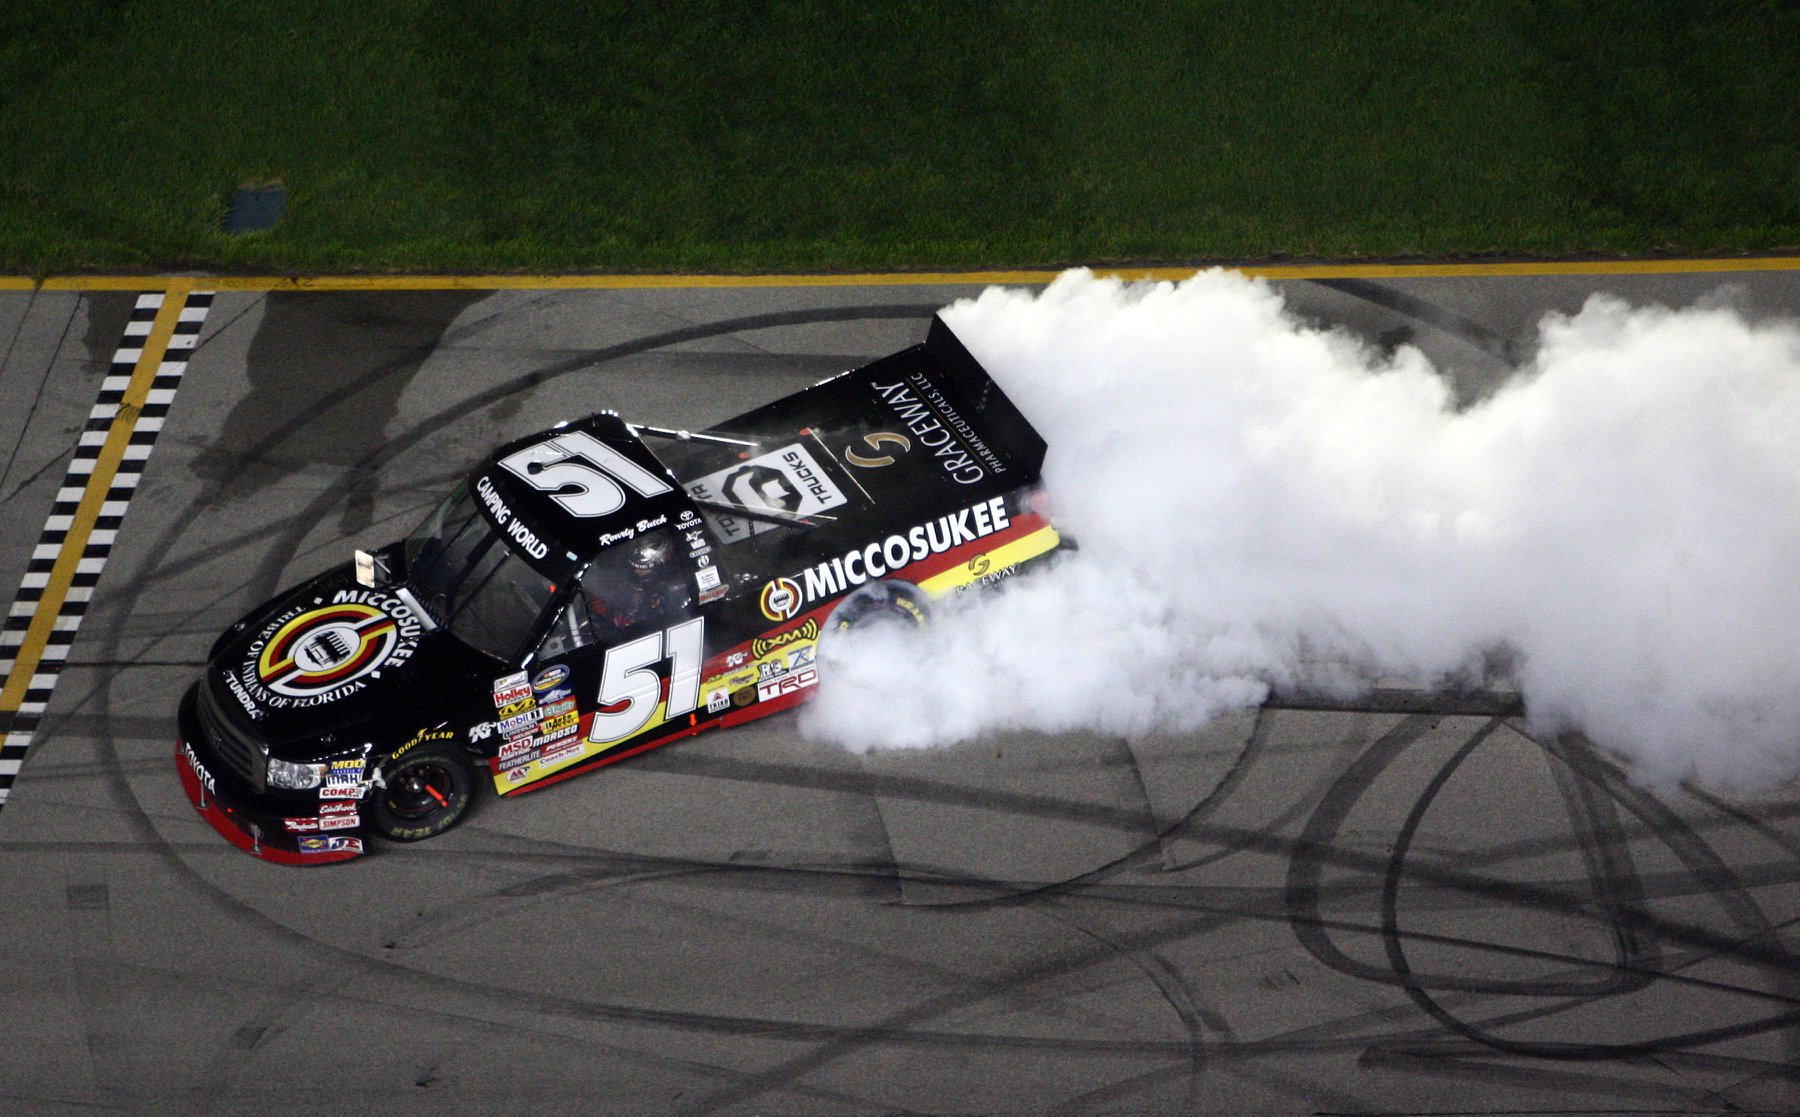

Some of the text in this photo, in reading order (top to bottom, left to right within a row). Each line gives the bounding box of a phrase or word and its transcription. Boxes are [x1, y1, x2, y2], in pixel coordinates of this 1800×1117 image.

[874, 382, 984, 484] GRACEWAY
[911, 372, 1006, 474] PHARMACEUTICALS, LLC
[498, 430, 674, 518] 51
[783, 451, 832, 504] TRUCKS
[477, 476, 548, 560] CAMPING WORLD
[599, 526, 635, 546] Rowdy
[677, 518, 702, 530] TOYOTA
[691, 484, 740, 537] TOTA
[803, 496, 1011, 603] MICCOSUKEE
[333, 590, 421, 667] MICCOSUKEE
[243, 606, 367, 708] TRIBE OF INDIANS OF FLORIDA
[589, 616, 704, 743] 51
[759, 669, 816, 694] TRD
[224, 670, 262, 720] TUNDRA
[495, 687, 530, 702] Holley
[392, 731, 454, 760] GOODYEAR
[500, 716, 528, 730] Mobil
[501, 740, 531, 755] MSD
[533, 724, 578, 747] MOROSO
[185, 742, 216, 796] TOYOTA
[331, 760, 367, 770] MOO
[323, 819, 356, 828] SIMPSON
